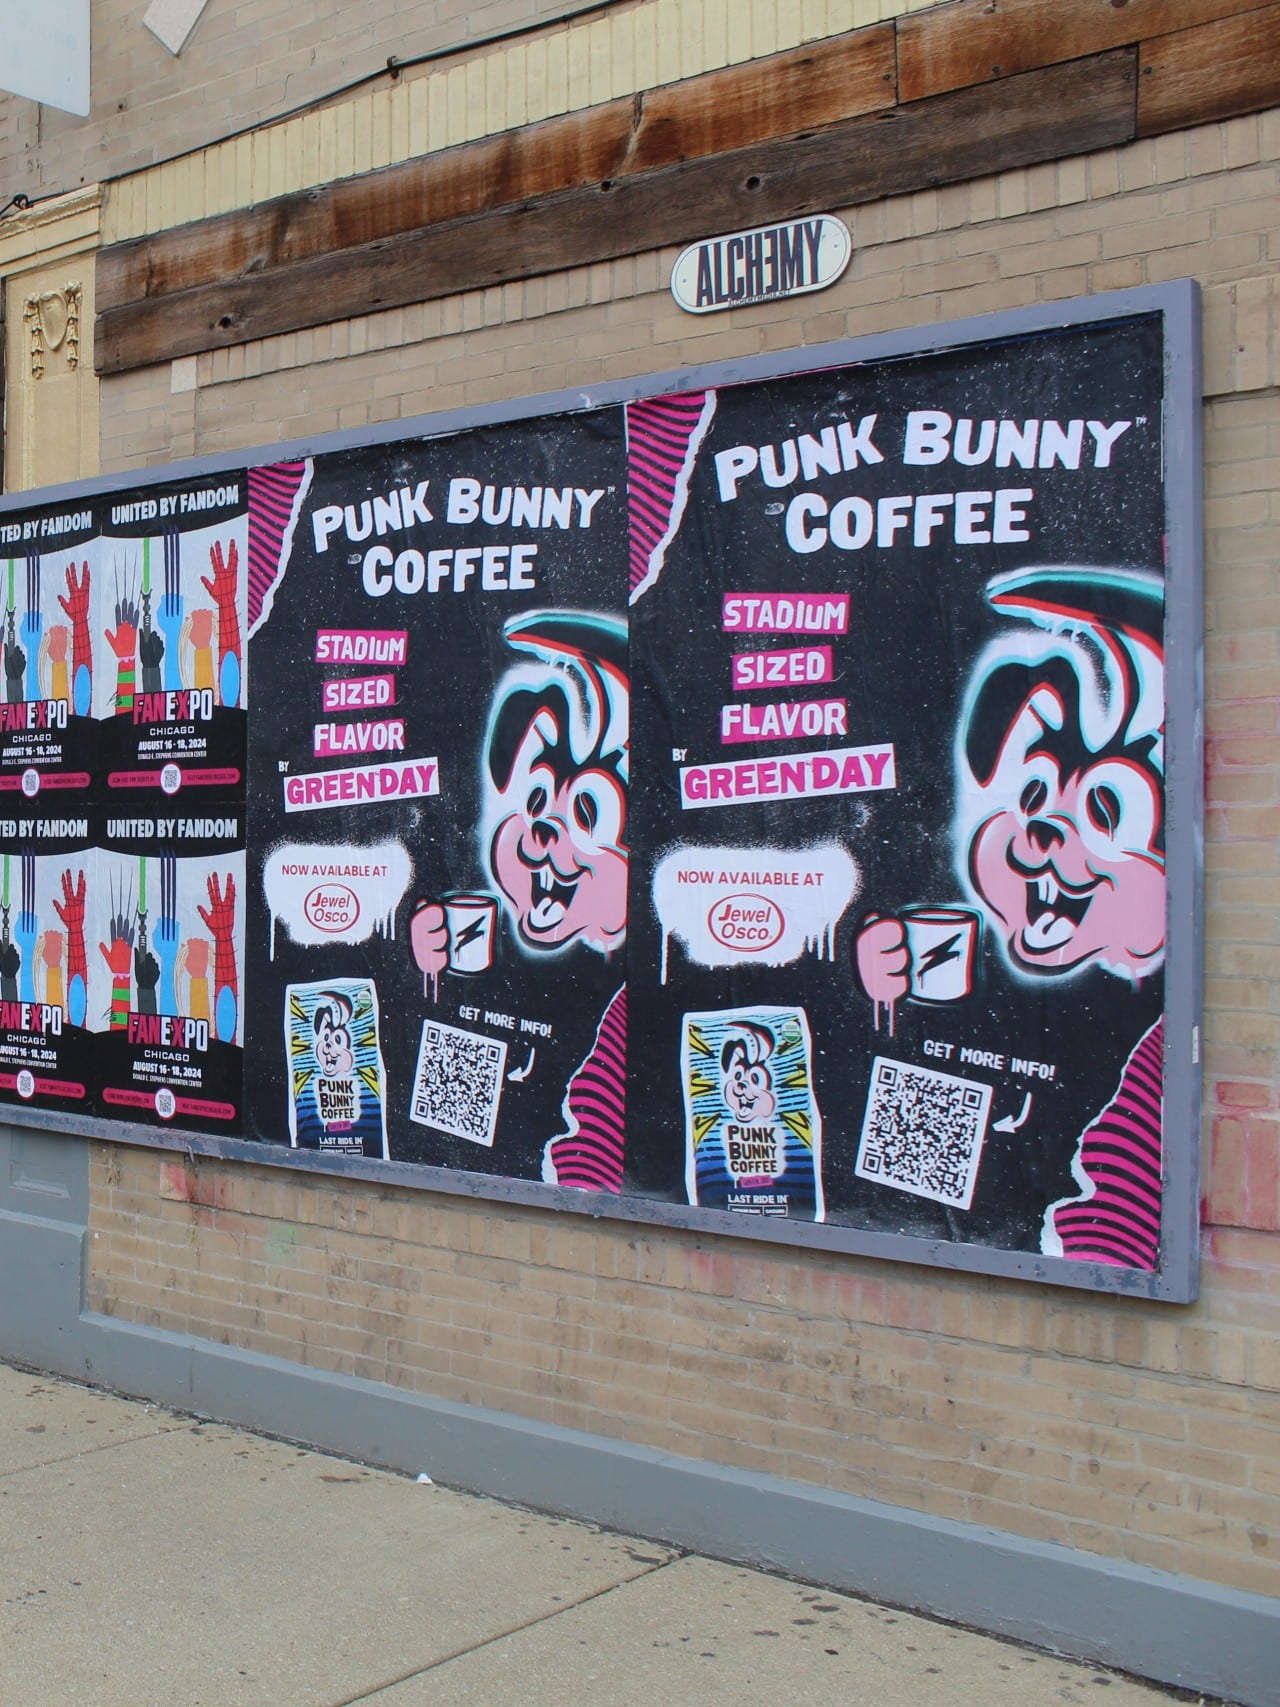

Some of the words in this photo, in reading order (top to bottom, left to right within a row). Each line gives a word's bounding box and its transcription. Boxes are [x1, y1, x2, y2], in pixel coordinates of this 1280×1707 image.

[714, 414, 884, 503] PUNK
[903, 410, 1131, 470] BUNNY
[112, 504, 156, 525] UNITED
[159, 499, 178, 518] BY
[180, 485, 239, 513] FANDOM
[312, 480, 434, 553] PUNK
[447, 477, 605, 530] BUNNY
[785, 488, 1033, 555] COFFEE
[24, 525, 39, 539] BY
[41, 511, 92, 536] FANDOM
[362, 543, 538, 598] COFFEE
[723, 599, 846, 631] STADIUM
[316, 635, 405, 661] STADIUM
[736, 652, 826, 684] SIZED
[326, 680, 390, 707] SIZED
[722, 703, 846, 737] FLAVOR
[13, 733, 51, 743] CHICAGO
[150, 726, 194, 736] CHICAGO
[314, 722, 404, 750] FLAVOR
[3, 747, 24, 757] AUGUST
[26, 747, 32, 756] 16
[46, 745, 62, 754] 2024
[138, 740, 163, 751] AUGUST
[165, 740, 172, 749] 16
[189, 738, 206, 748] 2024
[672, 748, 687, 761] BY
[278, 761, 289, 772] BY
[19, 819, 34, 838] BY
[36, 819, 88, 838] FANDOM
[107, 819, 153, 838] UNITED
[156, 819, 174, 838] BY
[176, 818, 237, 839] FANDOM
[282, 865, 310, 877] NOW
[312, 865, 371, 877] AVAILABLE
[372, 865, 388, 877] AT
[678, 871, 714, 884] NOW
[719, 871, 799, 885] AVAILABLE
[803, 872, 824, 886] AT
[311, 893, 350, 908] Jewel
[314, 908, 349, 923] Osco
[718, 904, 771, 923] Jewel
[721, 923, 769, 940] Osco
[459, 1006, 479, 1021] GET
[484, 1011, 514, 1030] MORE
[521, 1018, 552, 1038] INFO!
[7, 1034, 46, 1045] CHICAGO
[20, 1048, 26, 1056] 16
[31, 1050, 39, 1060] 18,
[41, 1051, 56, 1060] 2024
[144, 1050, 190, 1062] CHICAGO
[923, 1040, 954, 1060] GET
[960, 1048, 1004, 1072] MORE
[1011, 1057, 1056, 1081] INFO!
[133, 1061, 158, 1073] AUGUST
[159, 1064, 166, 1074] 16
[172, 1066, 182, 1078] 18,
[183, 1067, 201, 1079] 2024
[318, 1079, 353, 1093] PUNK
[320, 1093, 354, 1108] BUNNY
[321, 1108, 355, 1118] COFFEE
[319, 1137, 336, 1145] LAST
[338, 1137, 353, 1145] RIDE
[355, 1137, 363, 1145] IN
[728, 1125, 776, 1144] PUNK
[729, 1142, 777, 1159] BUNNY
[731, 1160, 777, 1173] COFFEE
[728, 1195, 752, 1204] LAST
[754, 1195, 775, 1204] RIDE
[777, 1195, 787, 1204] IN
